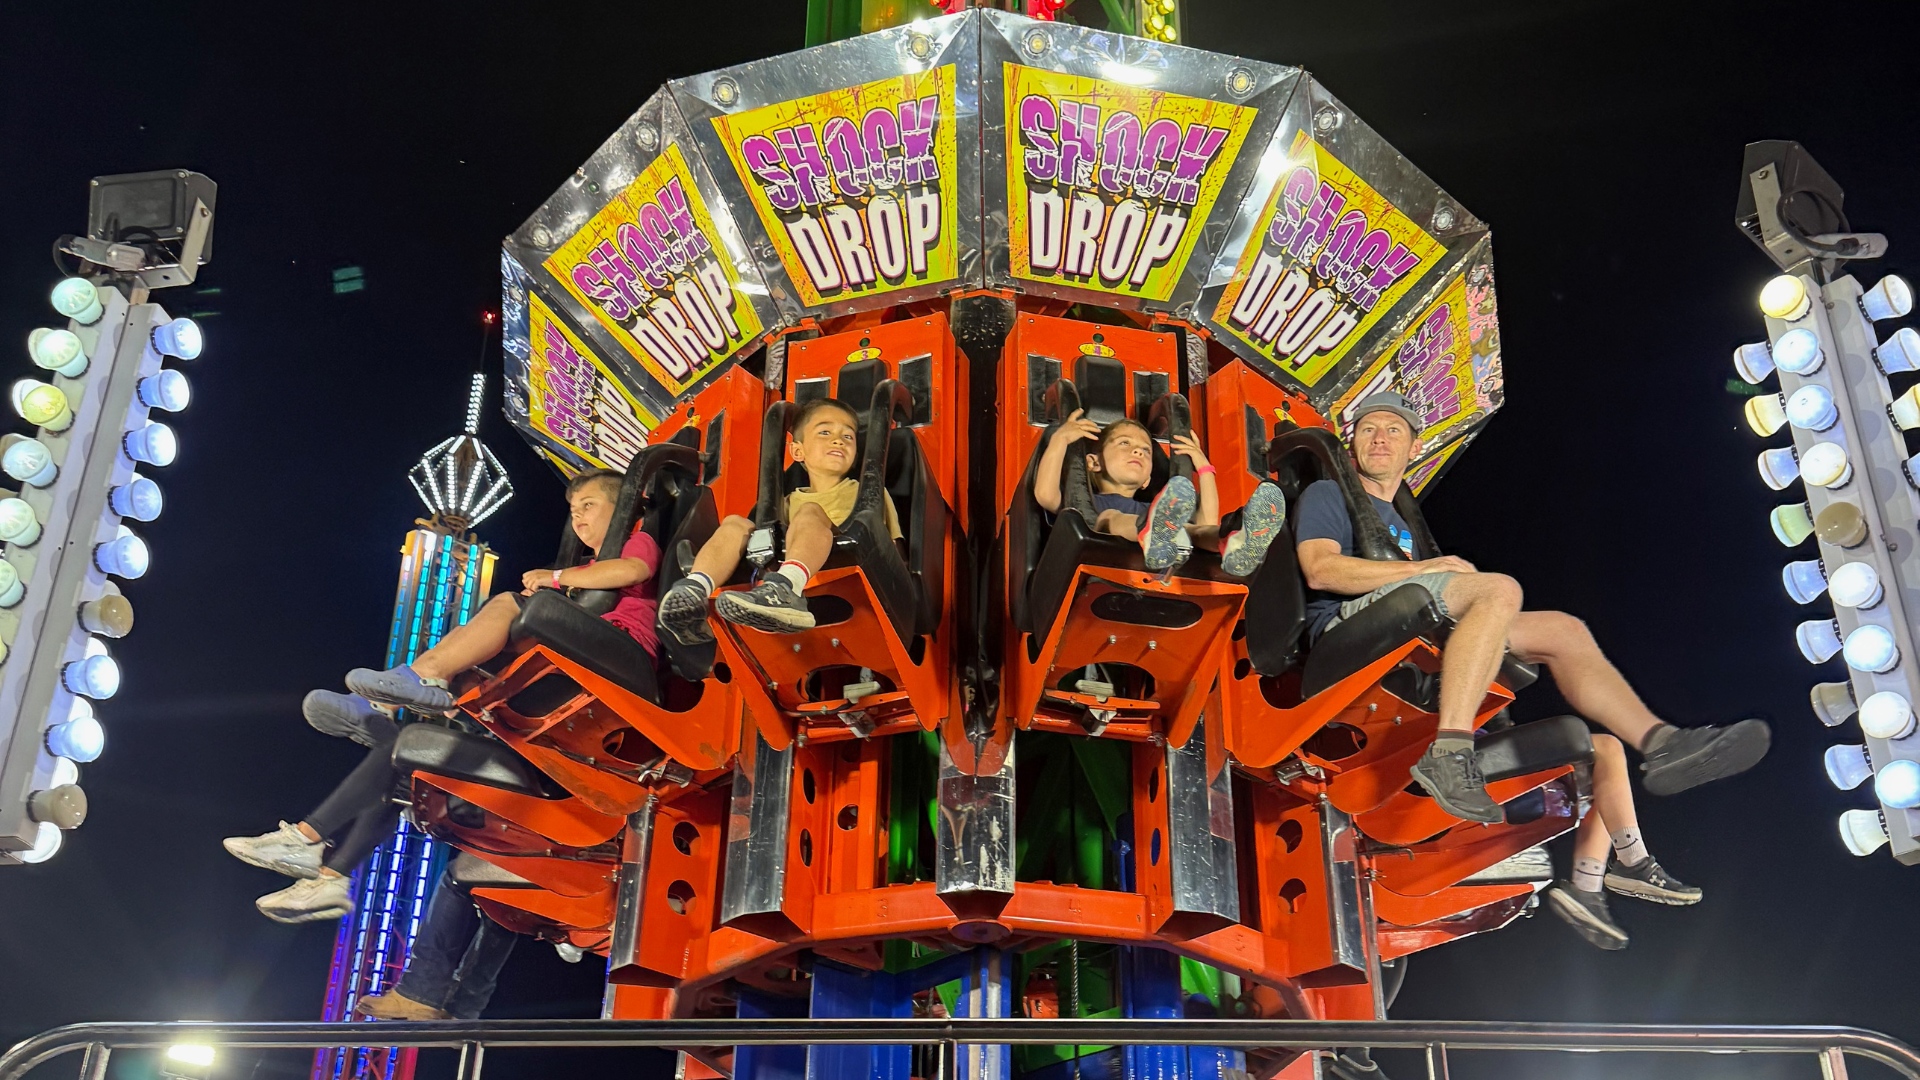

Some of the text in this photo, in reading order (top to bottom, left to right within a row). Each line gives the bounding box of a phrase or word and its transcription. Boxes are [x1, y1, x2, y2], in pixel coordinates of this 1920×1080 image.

[741, 95, 941, 211] SHOCK
[1020, 94, 1230, 206] SHOCK
[571, 174, 712, 320] SHOCK
[785, 193, 942, 292] DROP
[1028, 190, 1188, 286] DROP
[1269, 166, 1422, 313] SHOCK
[629, 258, 740, 380] DROP
[1231, 251, 1358, 366] DROP
[544, 317, 597, 453] SHOCK
